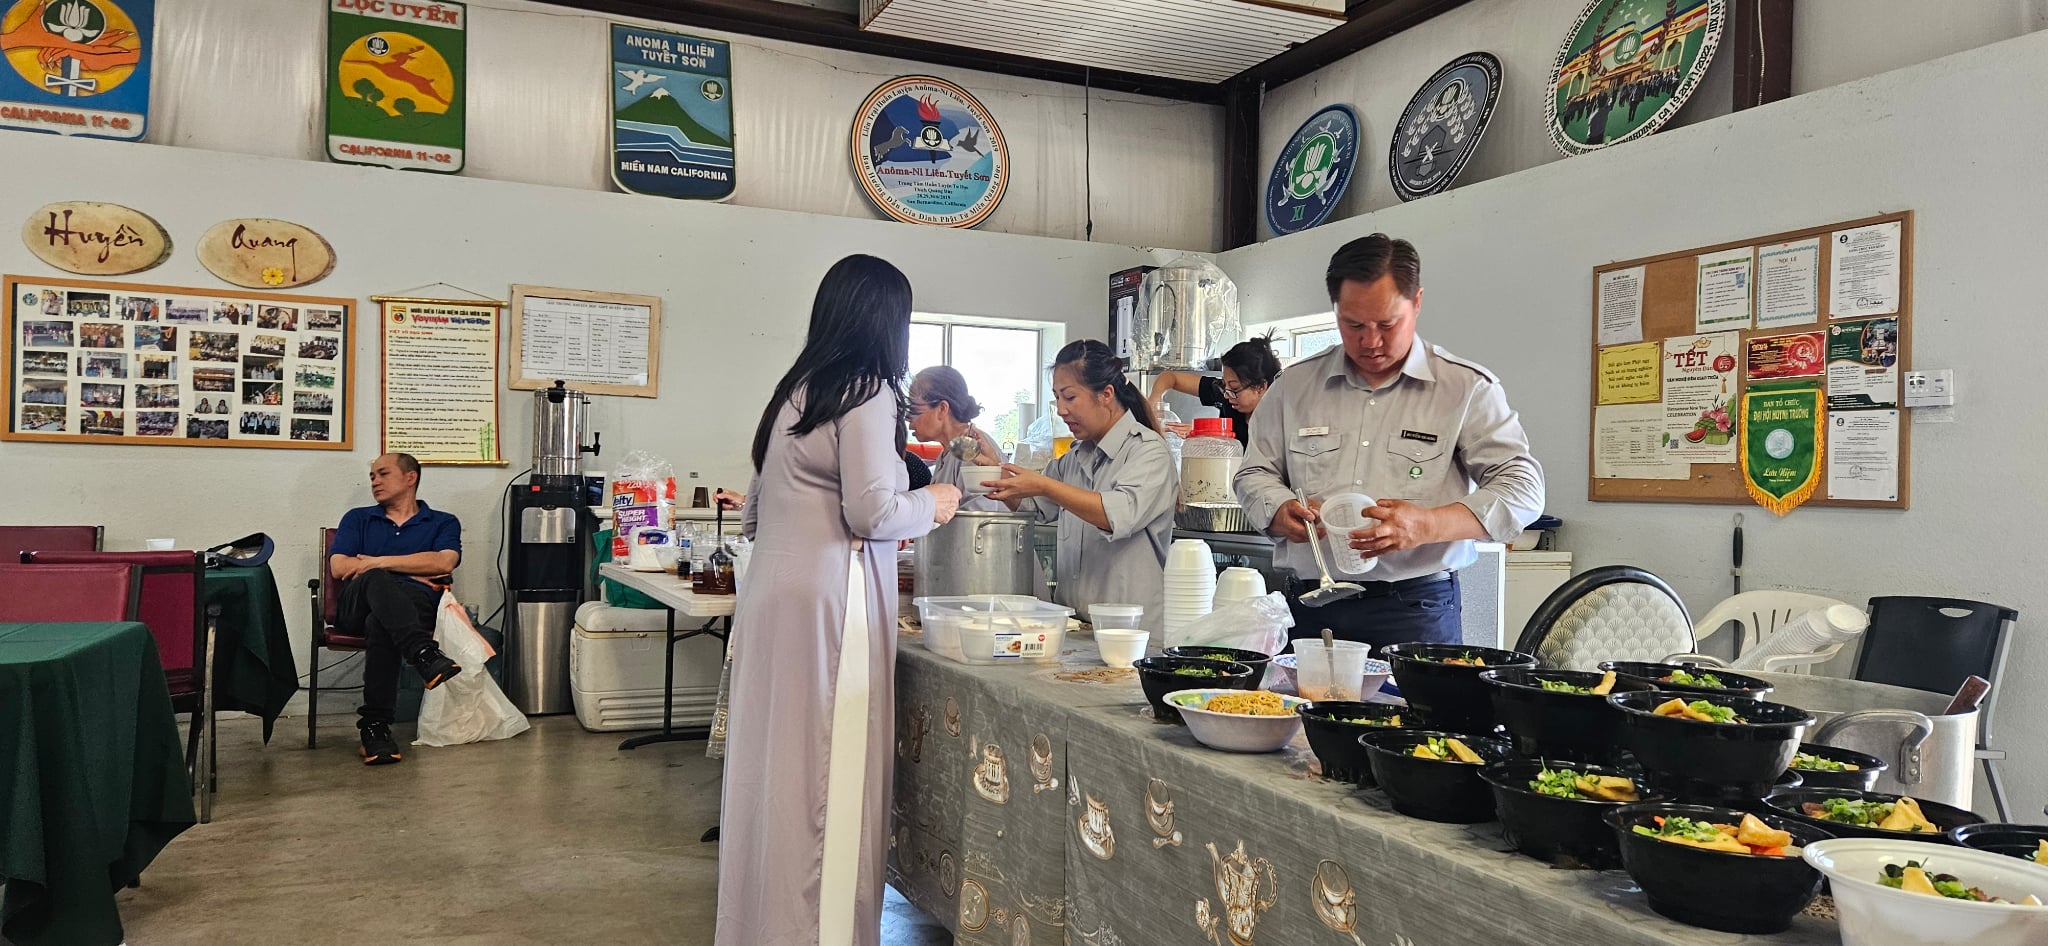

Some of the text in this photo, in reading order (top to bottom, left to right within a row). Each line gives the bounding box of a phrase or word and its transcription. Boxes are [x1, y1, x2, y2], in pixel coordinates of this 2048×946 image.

[626, 35, 670, 51] ANOMA
[1563, 19, 1584, 50] HUYNH
[0, 106, 131, 130] CALIFORNIA 11-02
[339, 143, 452, 164] CALIFORNIA 11-02
[647, 164, 669, 175] NAM
[671, 167, 728, 181] CALIFORNIA
[1674, 345, 1708, 368] TẾT
[618, 509, 646, 518] SUPER
